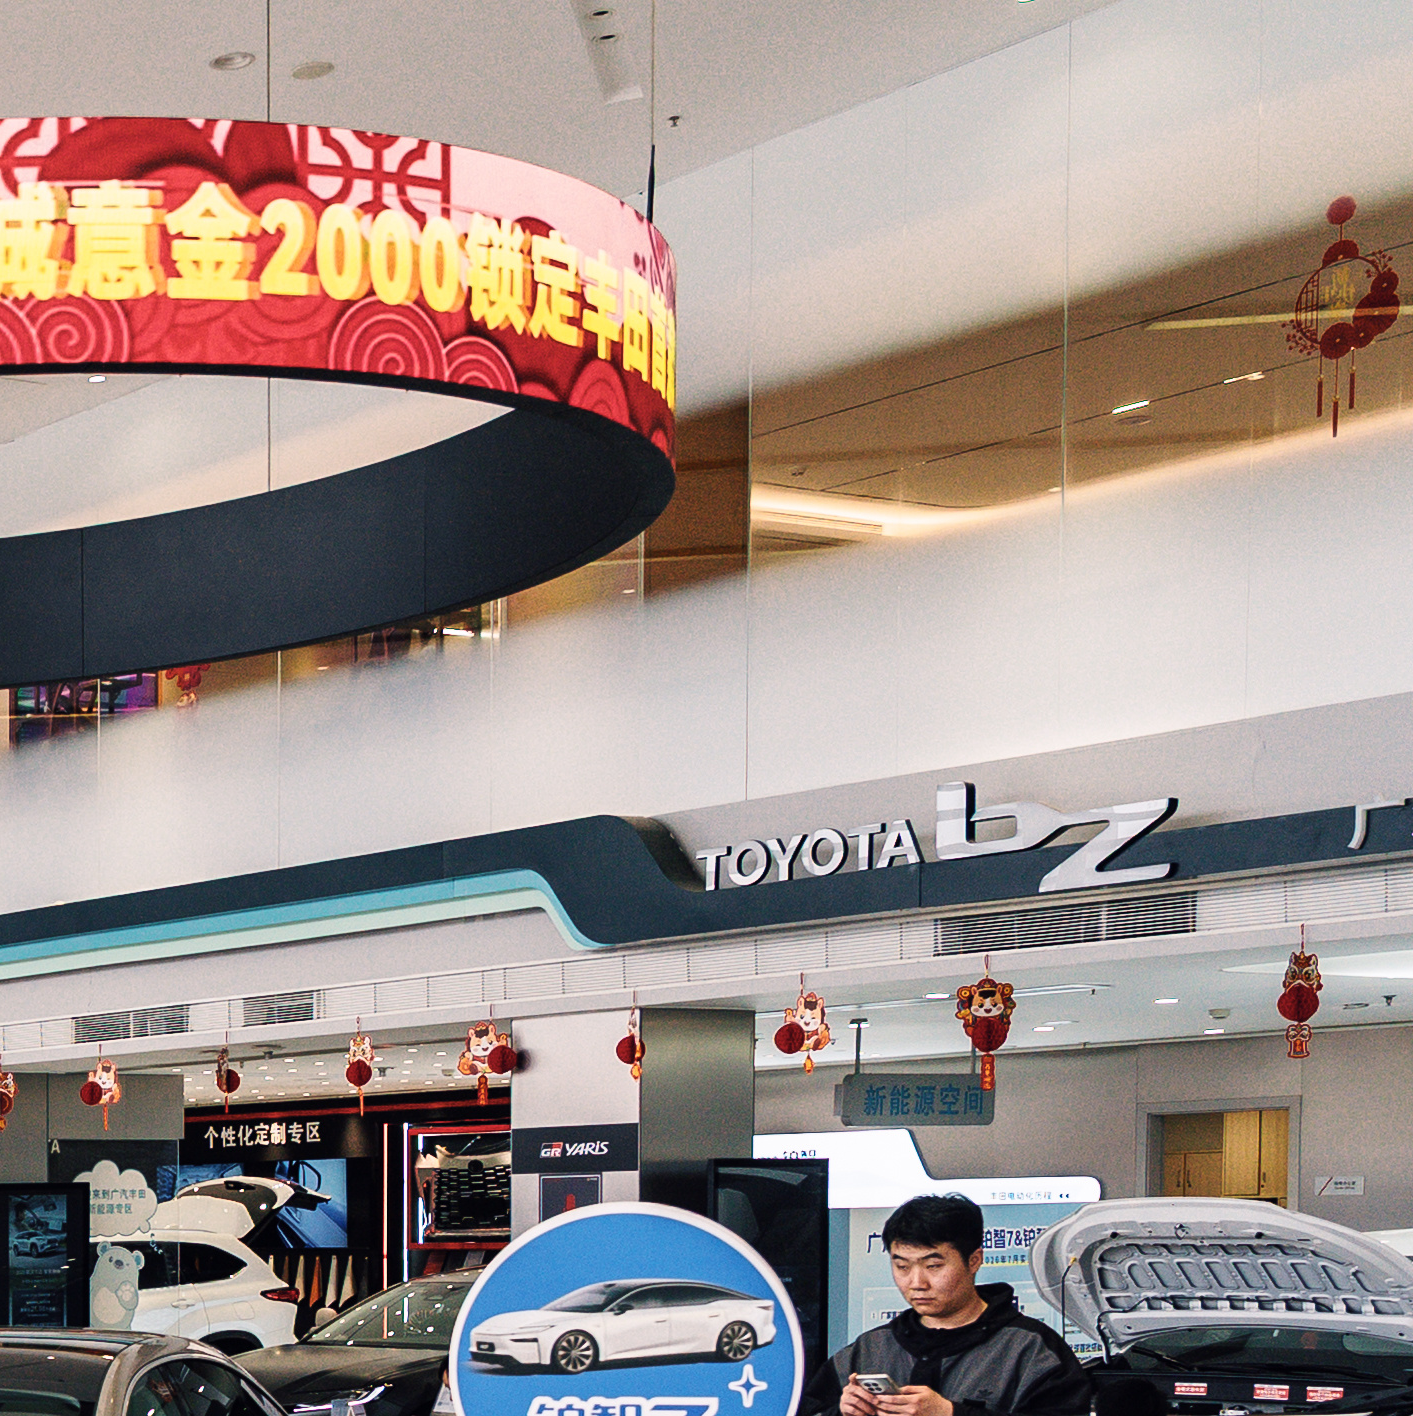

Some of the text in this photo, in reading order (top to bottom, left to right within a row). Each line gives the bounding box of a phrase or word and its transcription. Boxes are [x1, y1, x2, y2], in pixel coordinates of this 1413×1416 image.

[696, 818, 925, 891] TOYOTA
[864, 1084, 984, 1117] 新能源空间
[204, 1122, 321, 1149] 个性化定制专区
[540, 1141, 609, 1158] GR YARIS
[90, 1188, 147, 1200] 来到广汽丰田
